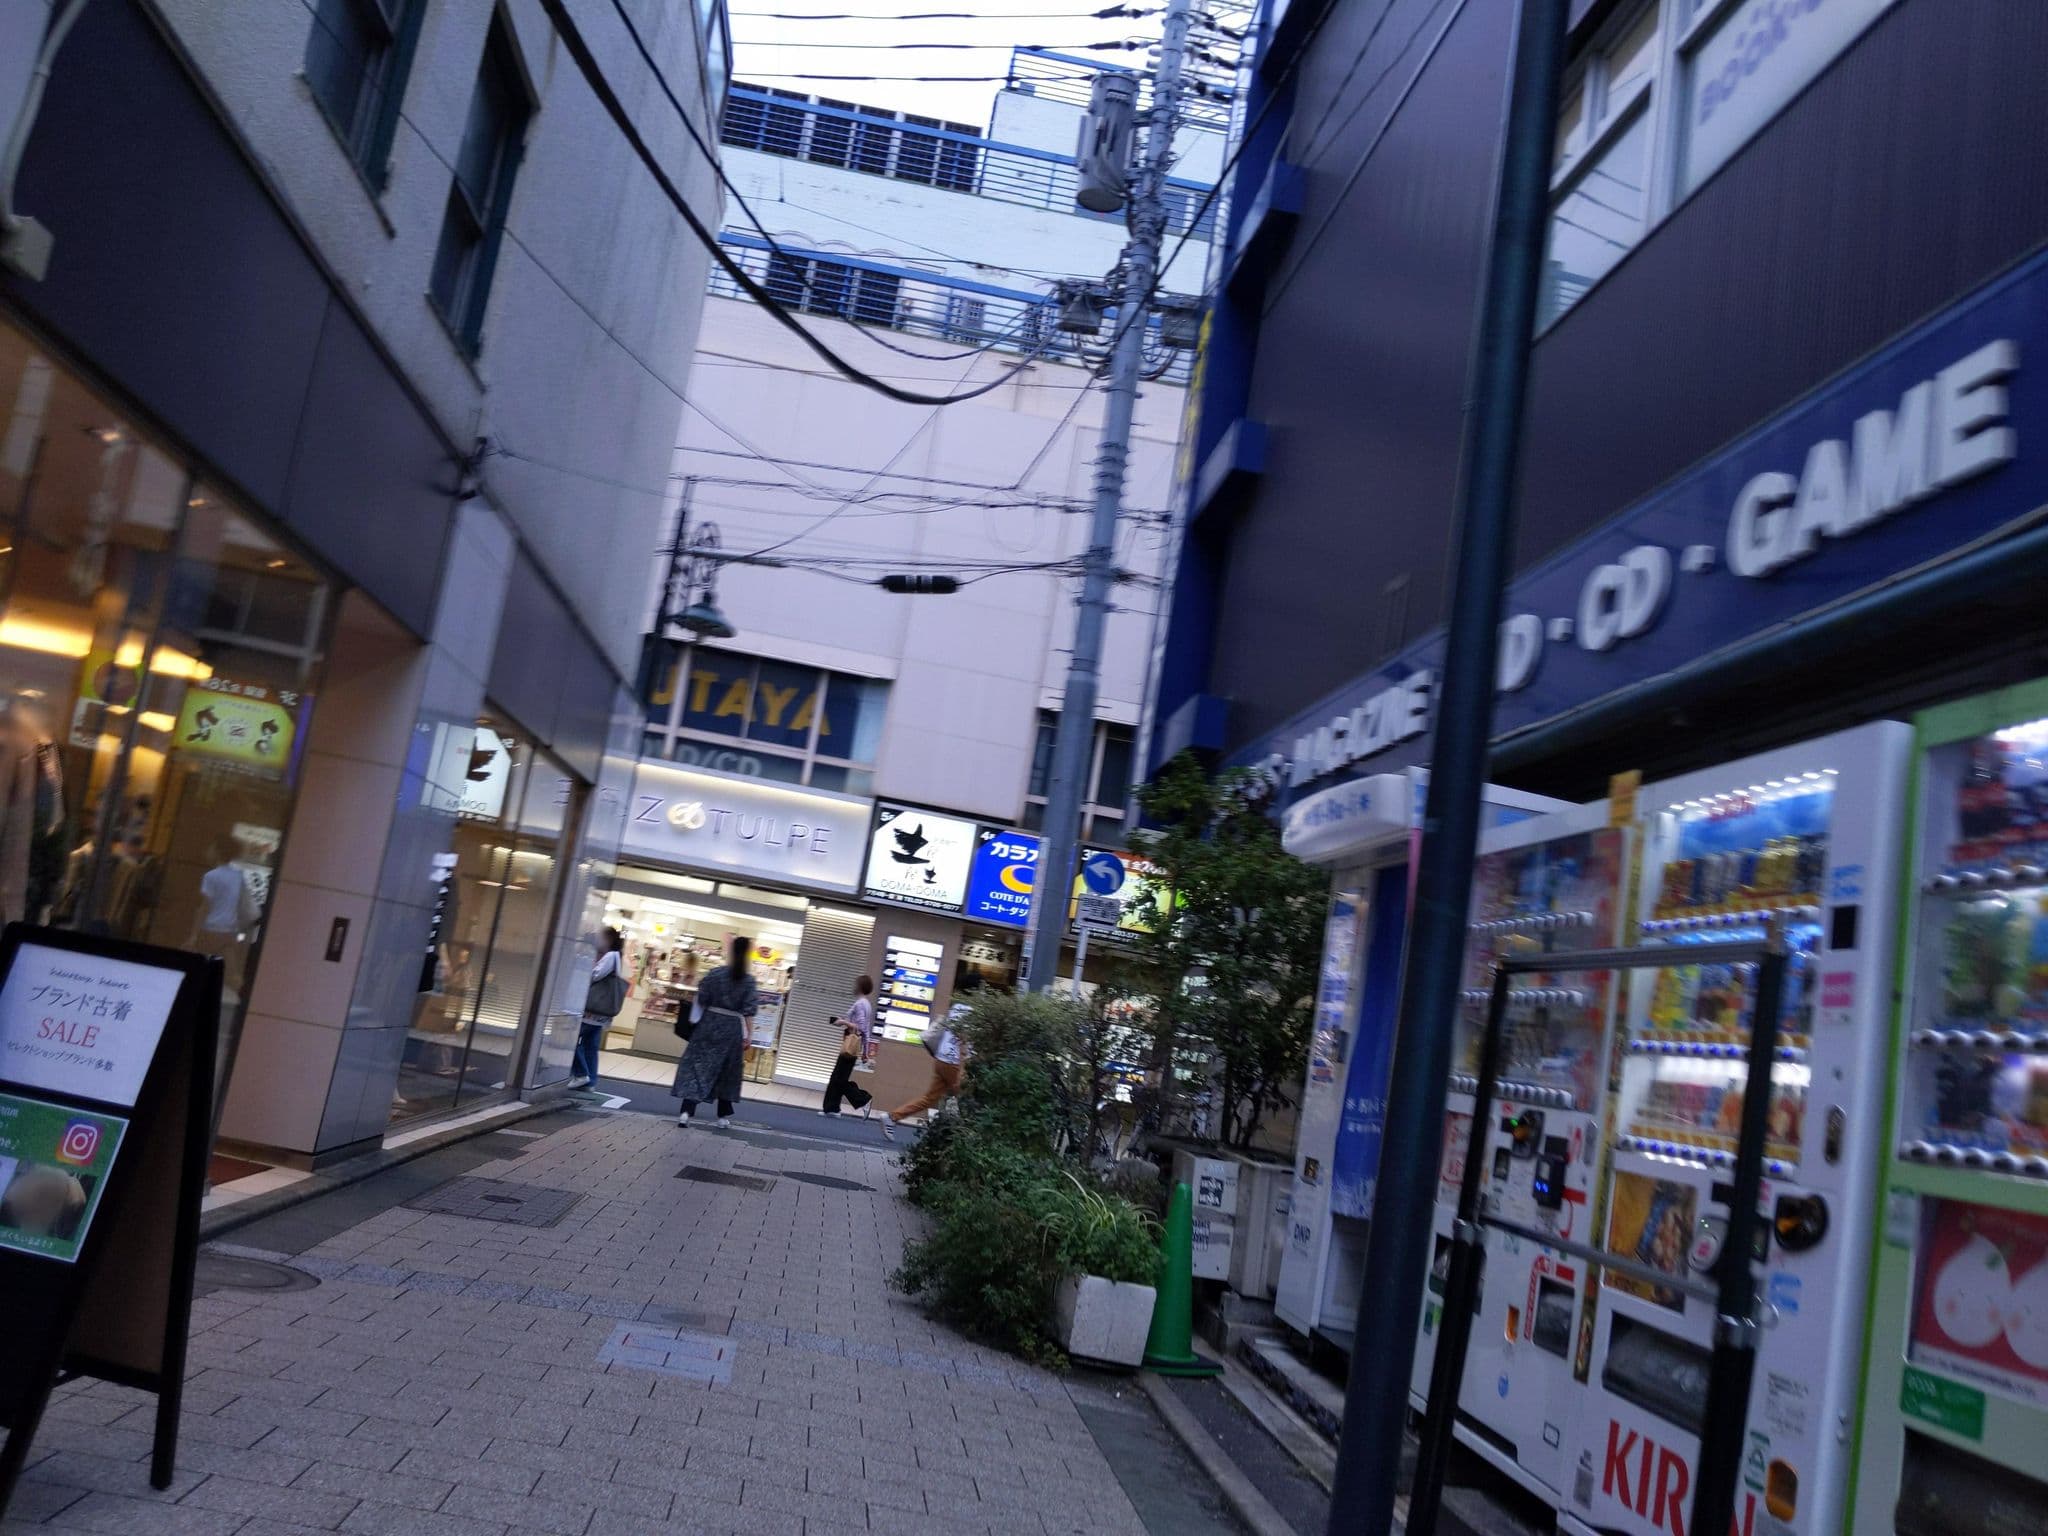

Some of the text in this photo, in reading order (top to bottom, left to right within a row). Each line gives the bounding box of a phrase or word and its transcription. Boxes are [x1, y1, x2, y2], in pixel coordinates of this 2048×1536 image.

[1726, 338, 2020, 579] GAME
[709, 807, 833, 855] TULPE
[30, 985, 133, 1022] ブランド古着
[37, 1017, 100, 1049] SALE
